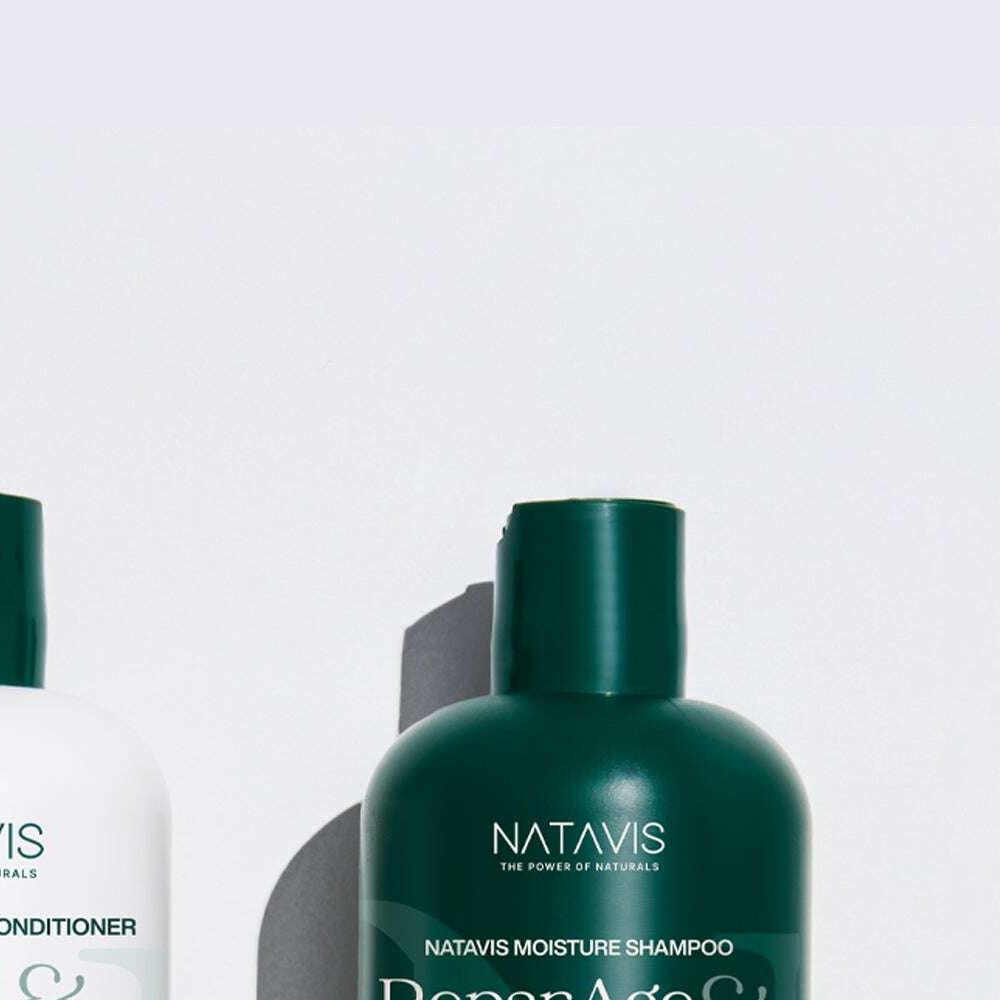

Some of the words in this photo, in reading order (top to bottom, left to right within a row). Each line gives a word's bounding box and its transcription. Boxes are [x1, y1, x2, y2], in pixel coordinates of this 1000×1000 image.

[493, 821, 666, 856] NATAVIS
[501, 861, 524, 872] THE
[528, 861, 571, 872] POWER
[576, 861, 591, 872] OF
[596, 861, 660, 872] NATURALS
[425, 940, 509, 957] NATAVIS
[514, 940, 620, 957] MOISTURE
[625, 940, 734, 957] SHAMPOO
